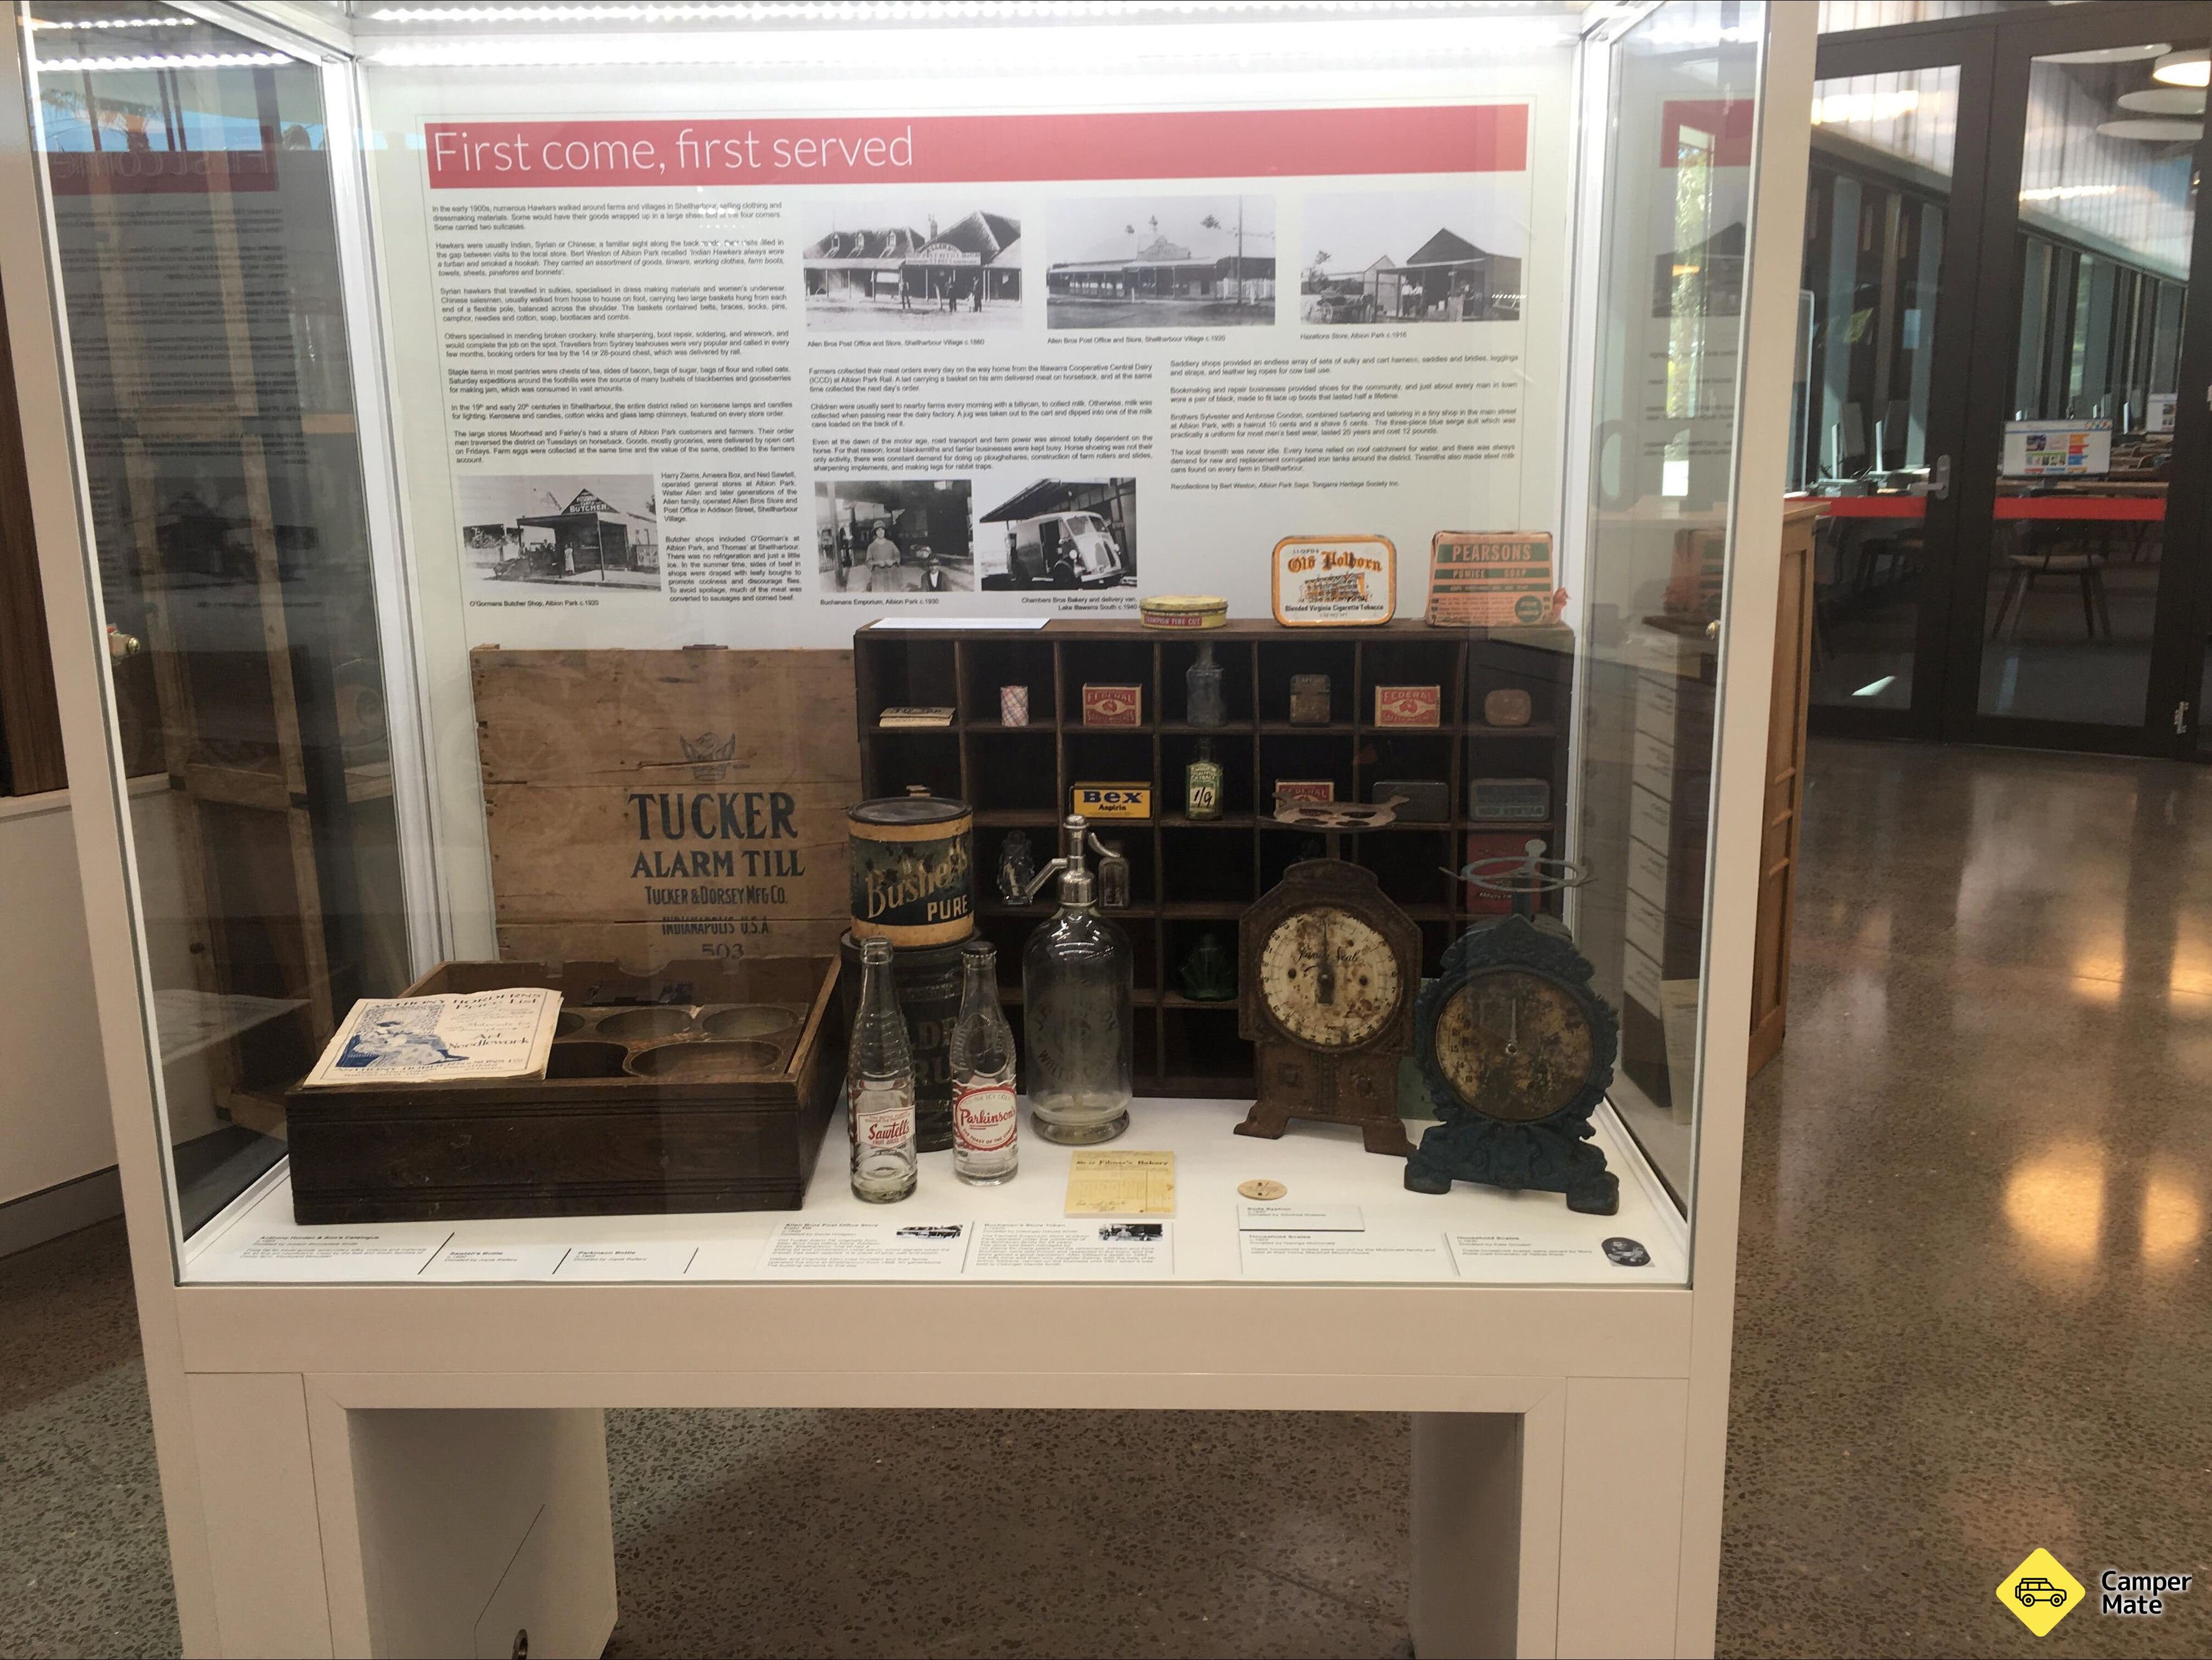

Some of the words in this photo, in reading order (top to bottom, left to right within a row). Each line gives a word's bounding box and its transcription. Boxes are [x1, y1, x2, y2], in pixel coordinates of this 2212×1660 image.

[434, 132, 530, 171] First
[543, 141, 666, 175] come,
[676, 128, 761, 169] first
[773, 125, 912, 167] served
[1288, 555, 1316, 573] Old
[1321, 550, 1382, 573] Holborn
[1453, 545, 1531, 561] PEARSONS
[1453, 569, 1486, 579] PUMICE
[1505, 569, 1526, 578] SOAP
[1333, 604, 1359, 613] Cigarette
[1384, 692, 1432, 702] FEDERAL
[1083, 791, 1142, 803] Bex
[628, 792, 798, 840] TUCKER
[631, 850, 734, 878] ALARM
[742, 849, 805, 877] TILL
[644, 885, 688, 905] TUCKER
[927, 894, 967, 921] PURE
[662, 916, 735, 935] INDIANAPOLIS
[702, 943, 744, 960] 503
[448, 1036, 530, 1050] Needlework
